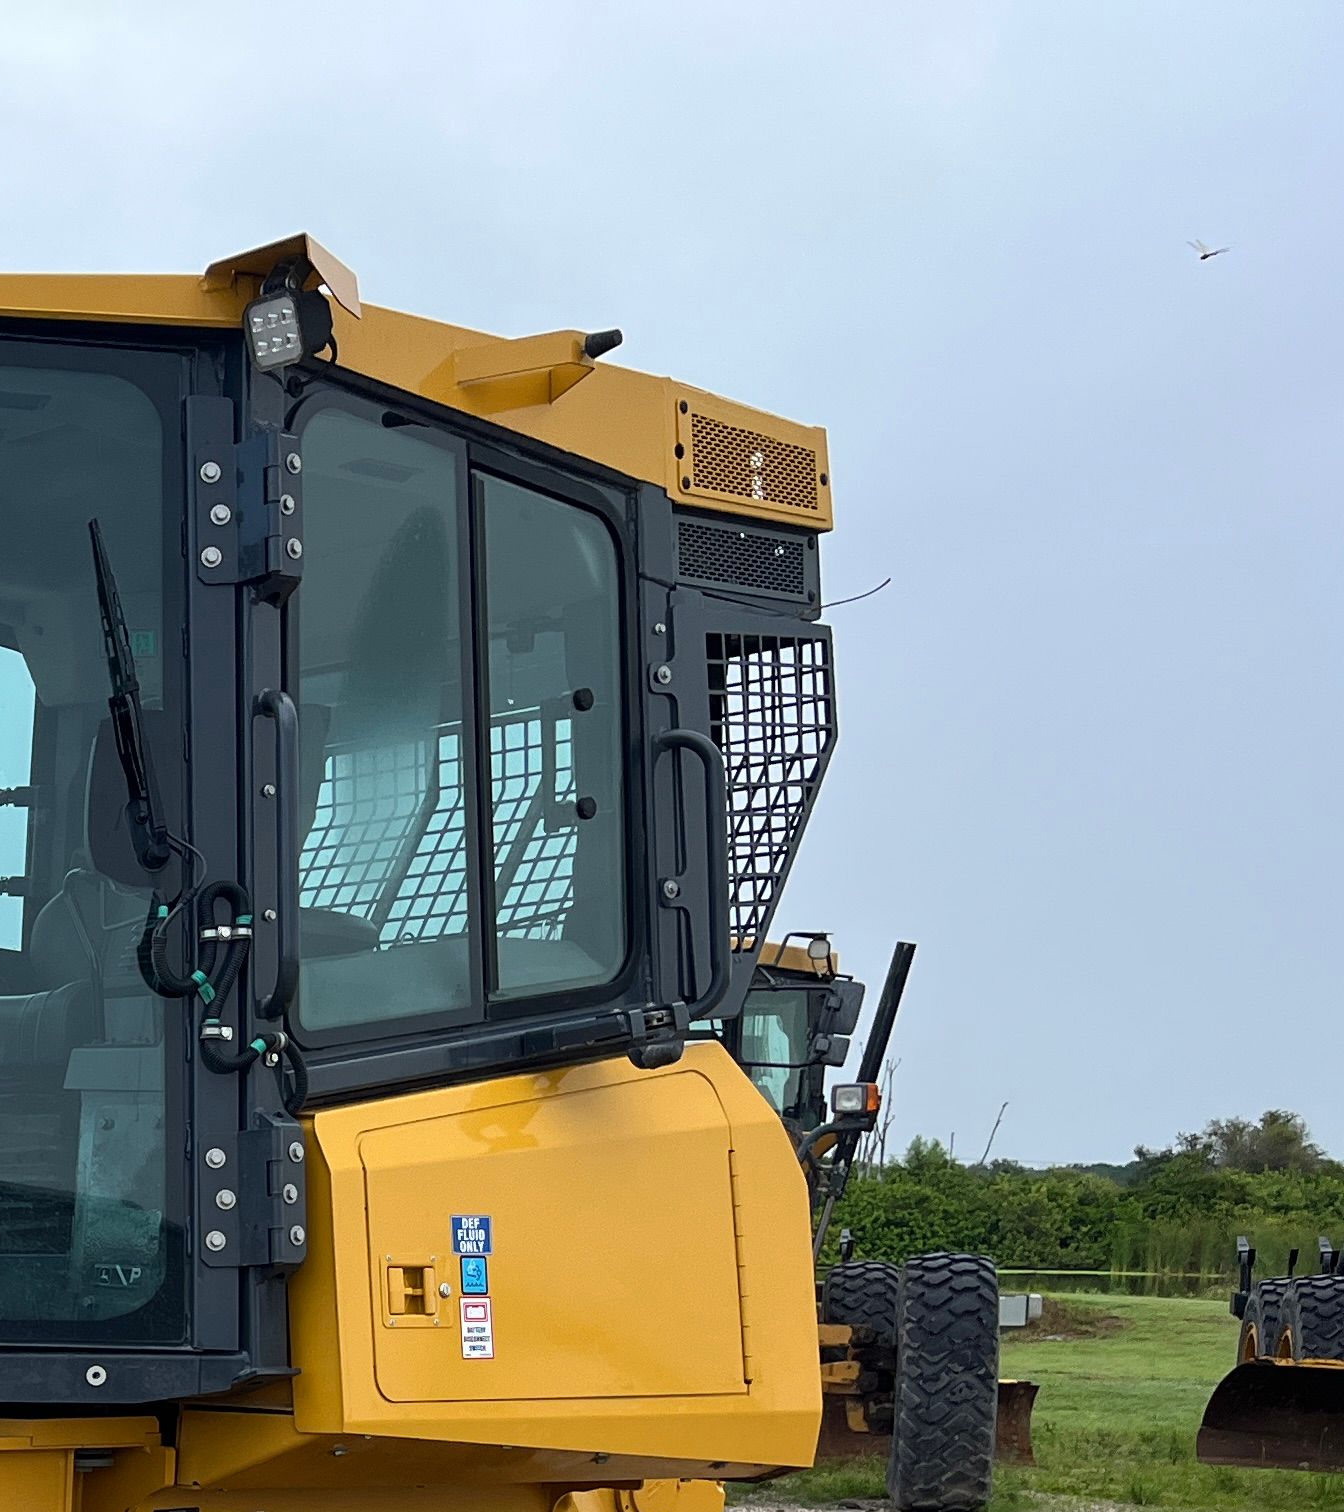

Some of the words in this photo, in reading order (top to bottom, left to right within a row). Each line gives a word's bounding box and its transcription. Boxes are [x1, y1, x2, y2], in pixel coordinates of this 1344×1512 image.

[461, 1217, 480, 1229] DEF
[457, 1229, 486, 1241] FLUID
[459, 1240, 484, 1253] ONLY
